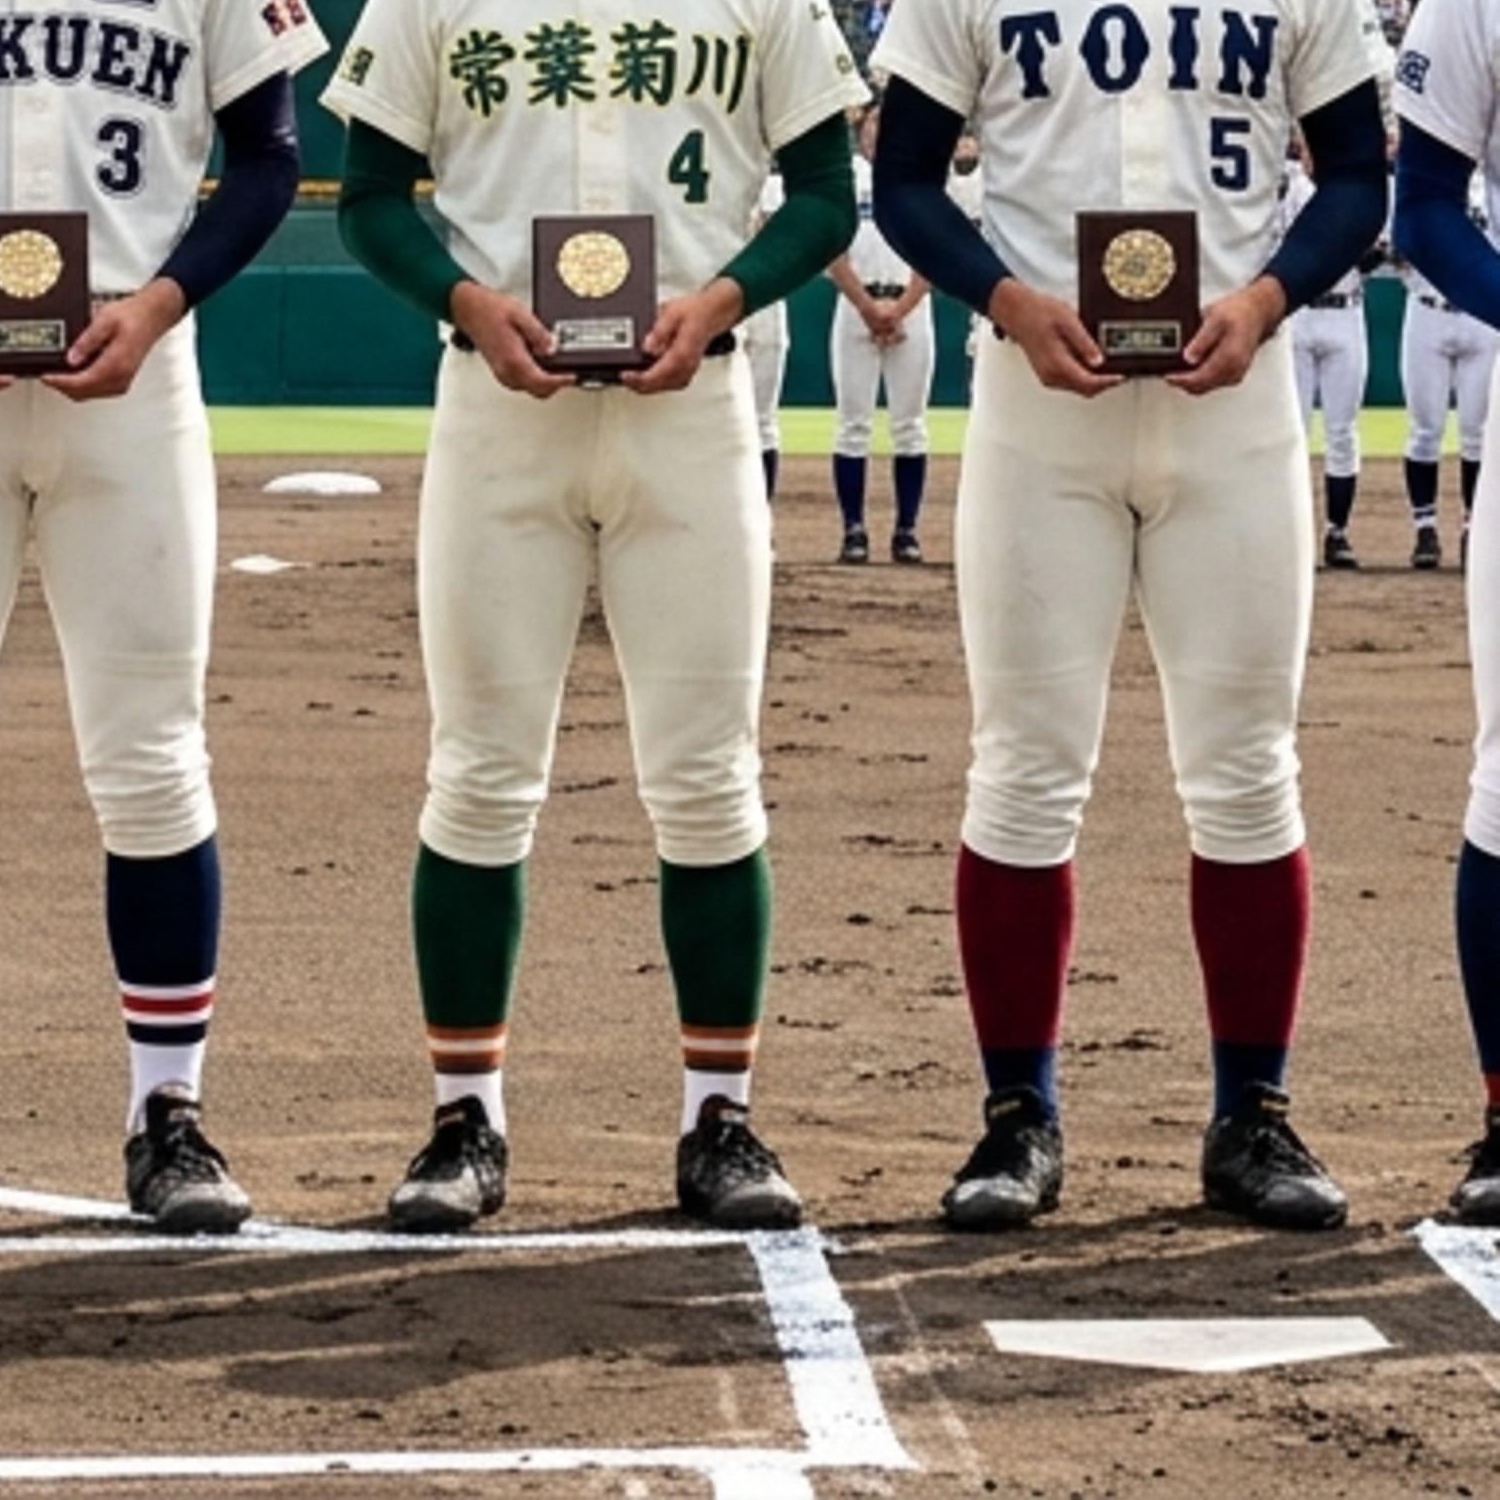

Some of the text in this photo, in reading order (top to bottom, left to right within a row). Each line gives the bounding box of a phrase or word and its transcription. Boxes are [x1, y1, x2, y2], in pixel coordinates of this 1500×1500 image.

[449, 19, 752, 118] 常葉菊川
[96, 116, 145, 197] 3
[667, 128, 711, 204] 4
[1210, 116, 1251, 192] 5
